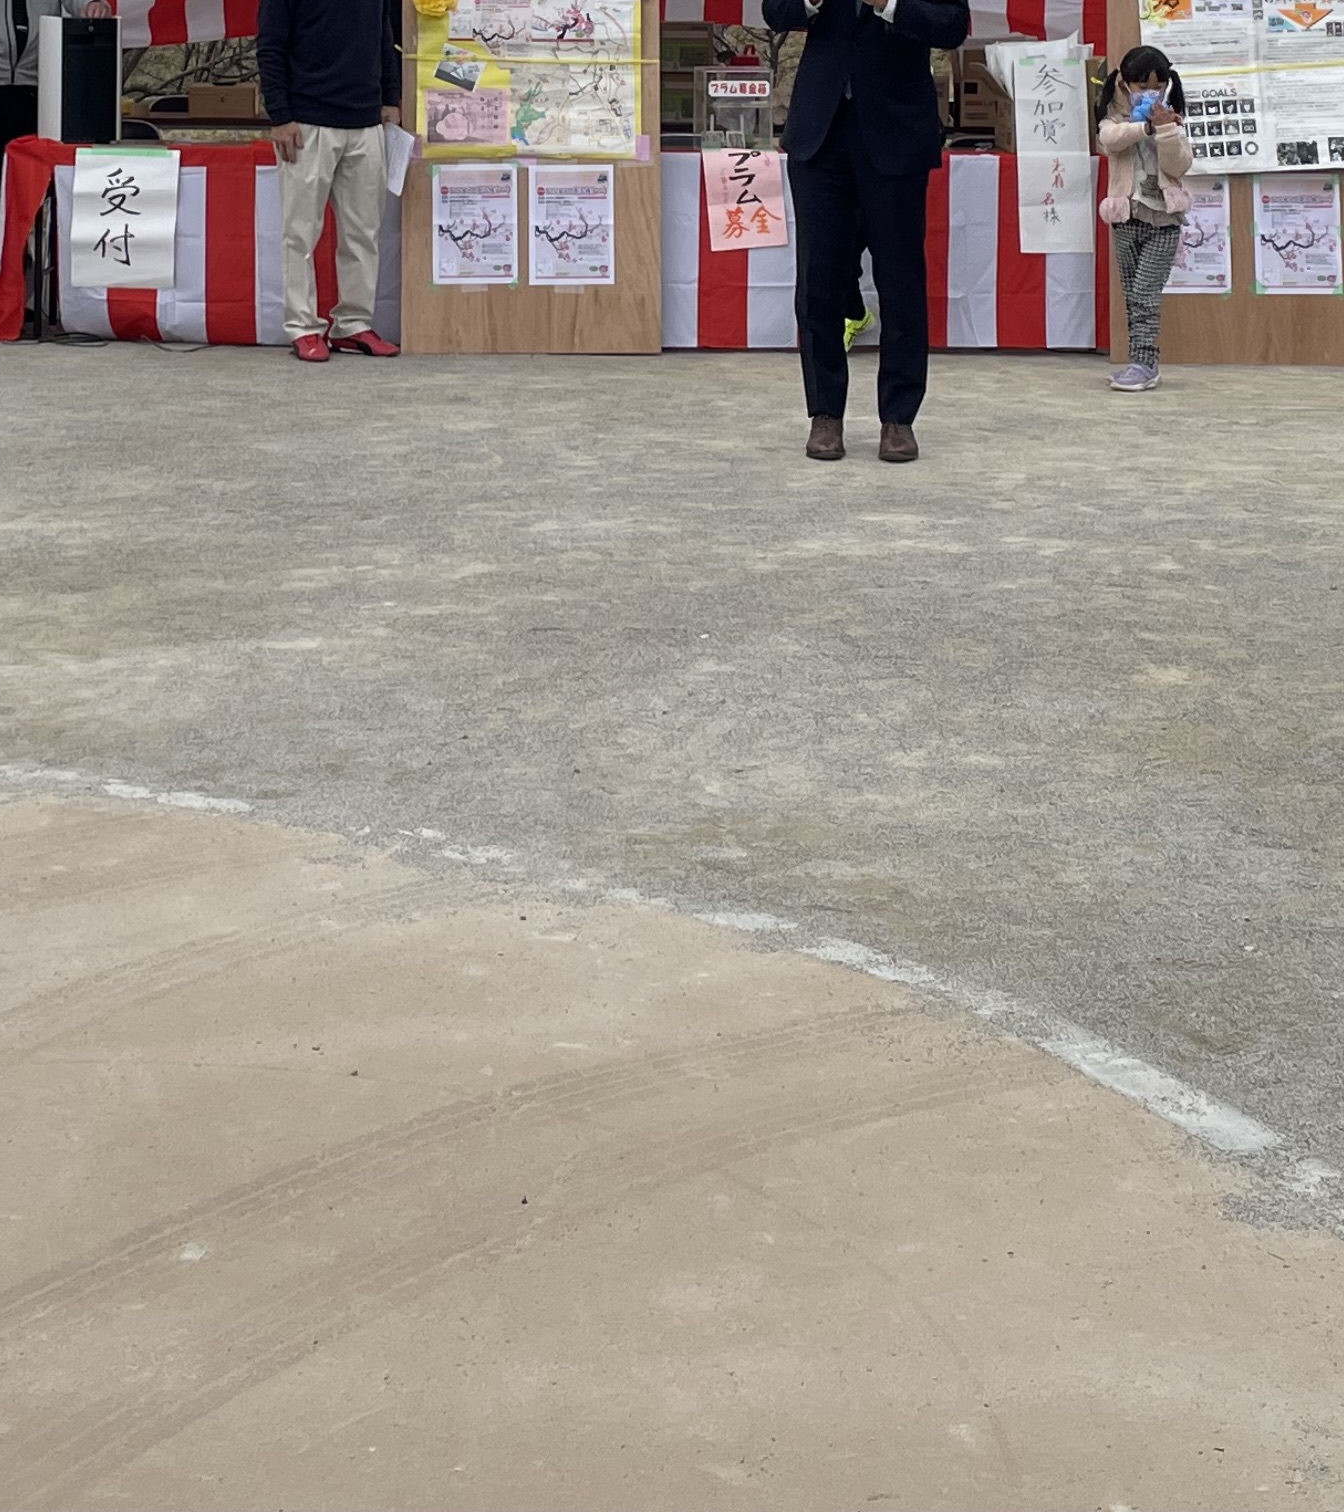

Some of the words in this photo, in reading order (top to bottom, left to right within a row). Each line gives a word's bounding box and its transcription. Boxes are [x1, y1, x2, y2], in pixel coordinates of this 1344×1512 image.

[1031, 63, 1078, 145] 参加賞
[1201, 87, 1237, 98] GOALS
[727, 150, 763, 205] プラム
[92, 167, 142, 267] 受付
[722, 204, 782, 240] 募金
